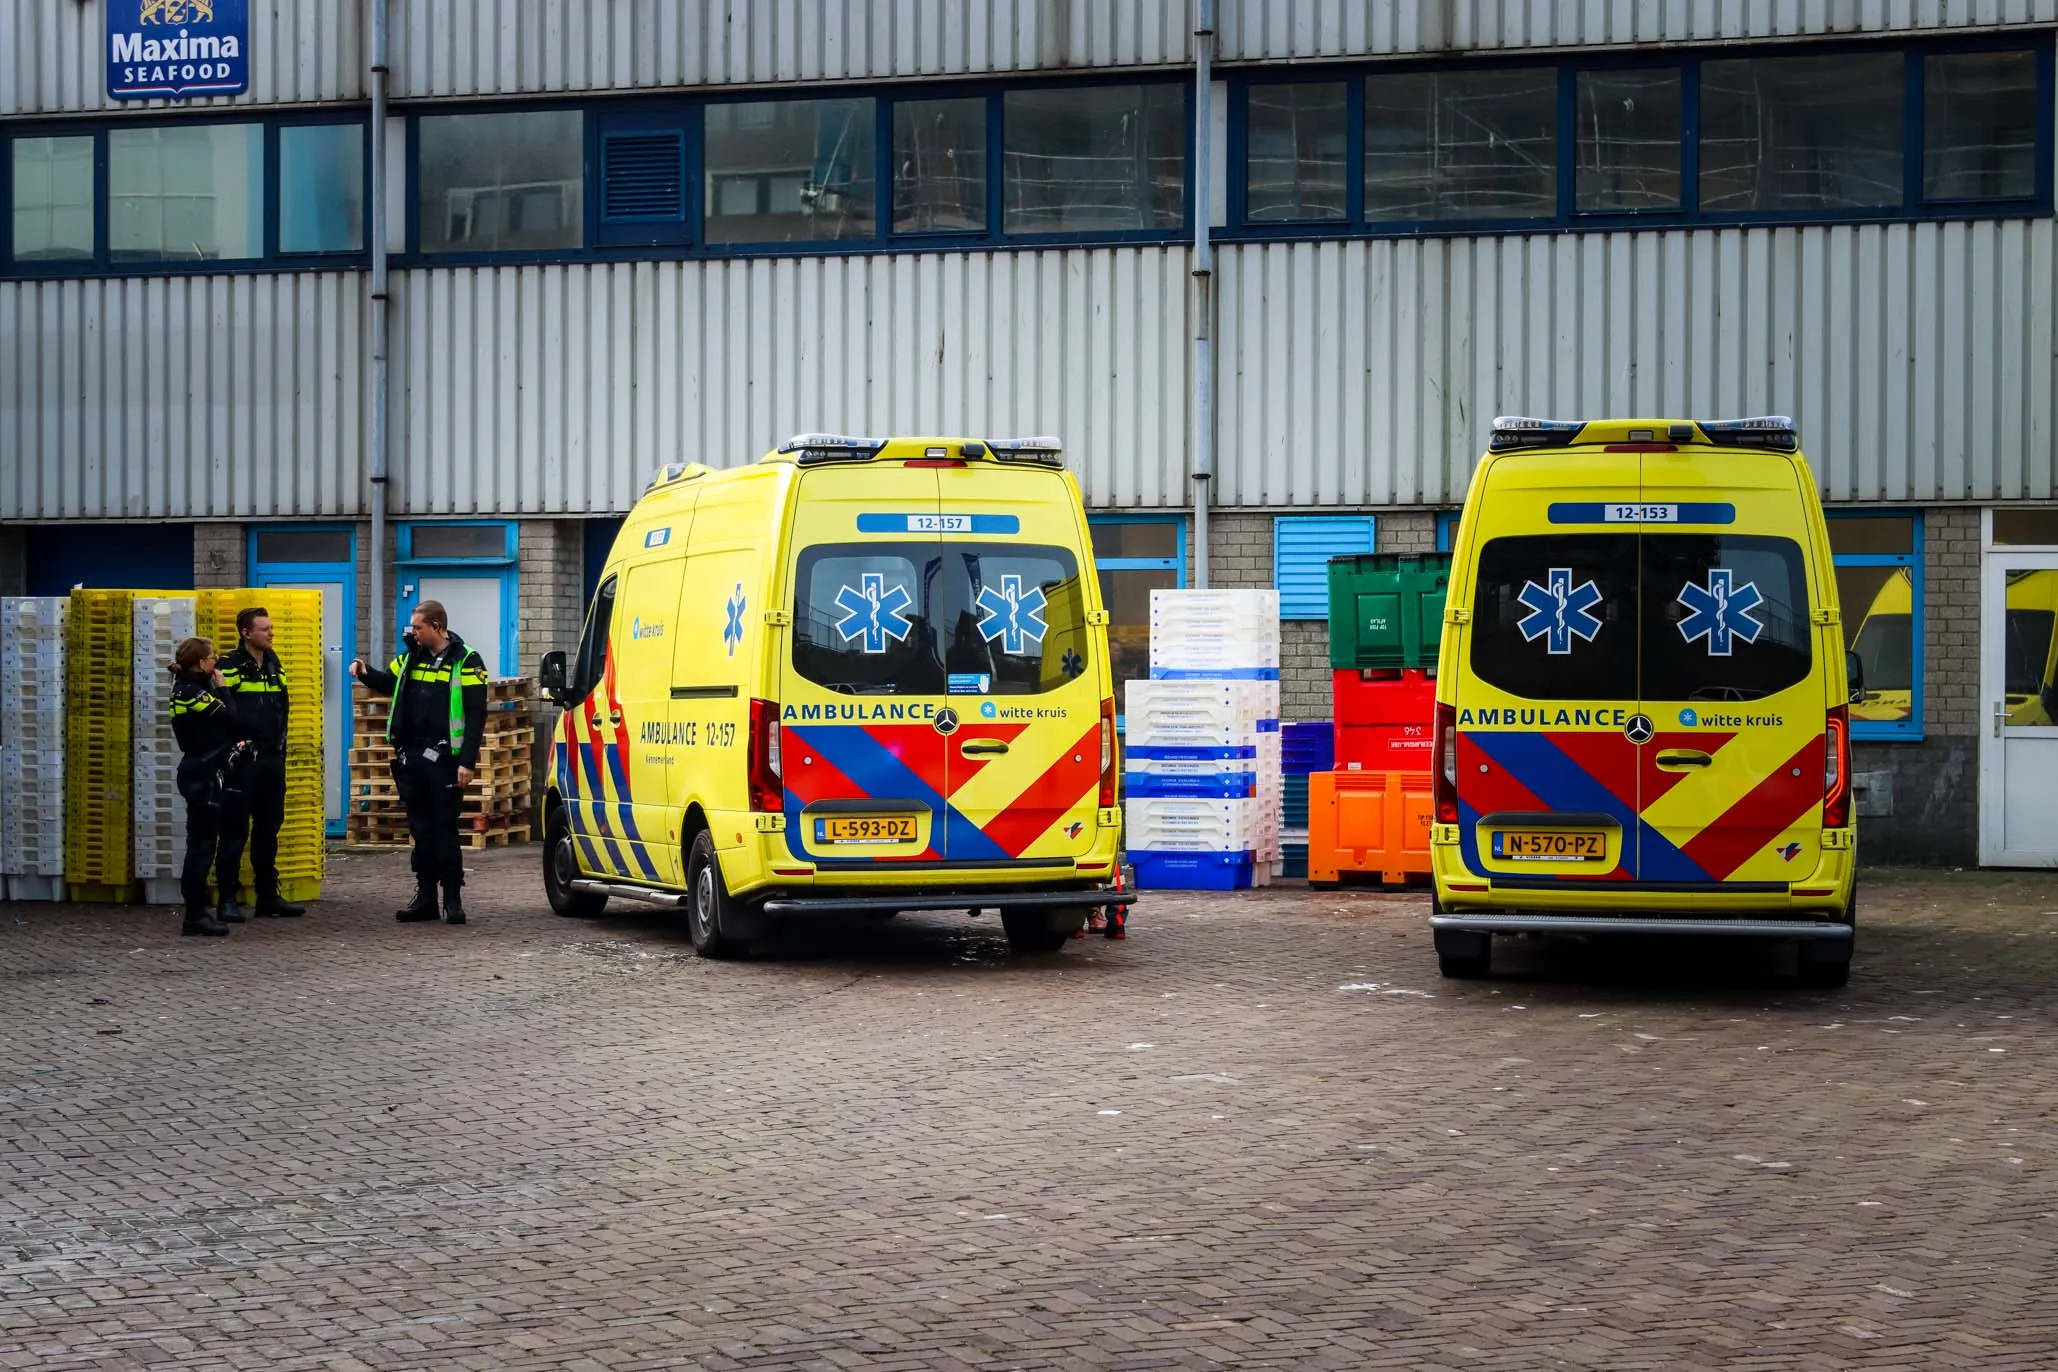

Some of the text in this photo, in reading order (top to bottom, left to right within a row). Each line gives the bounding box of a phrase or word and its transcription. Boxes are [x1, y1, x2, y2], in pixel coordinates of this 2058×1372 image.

[112, 29, 239, 63] Maxima
[124, 63, 231, 83] SEAFOOD
[1615, 507, 1668, 519] 12-153
[917, 518, 963, 529] 12-157
[783, 703, 934, 720] AMBULANCE
[1000, 707, 1067, 718] witte kruis
[1458, 708, 1625, 726] AMBULANCE
[1701, 713, 1783, 727] witte kruis
[640, 721, 735, 747] AMBULANCE 12-157
[1404, 726, 1422, 736] 346
[832, 820, 910, 837] L-593-DZ
[1510, 835, 1598, 853] N-570-PZ
